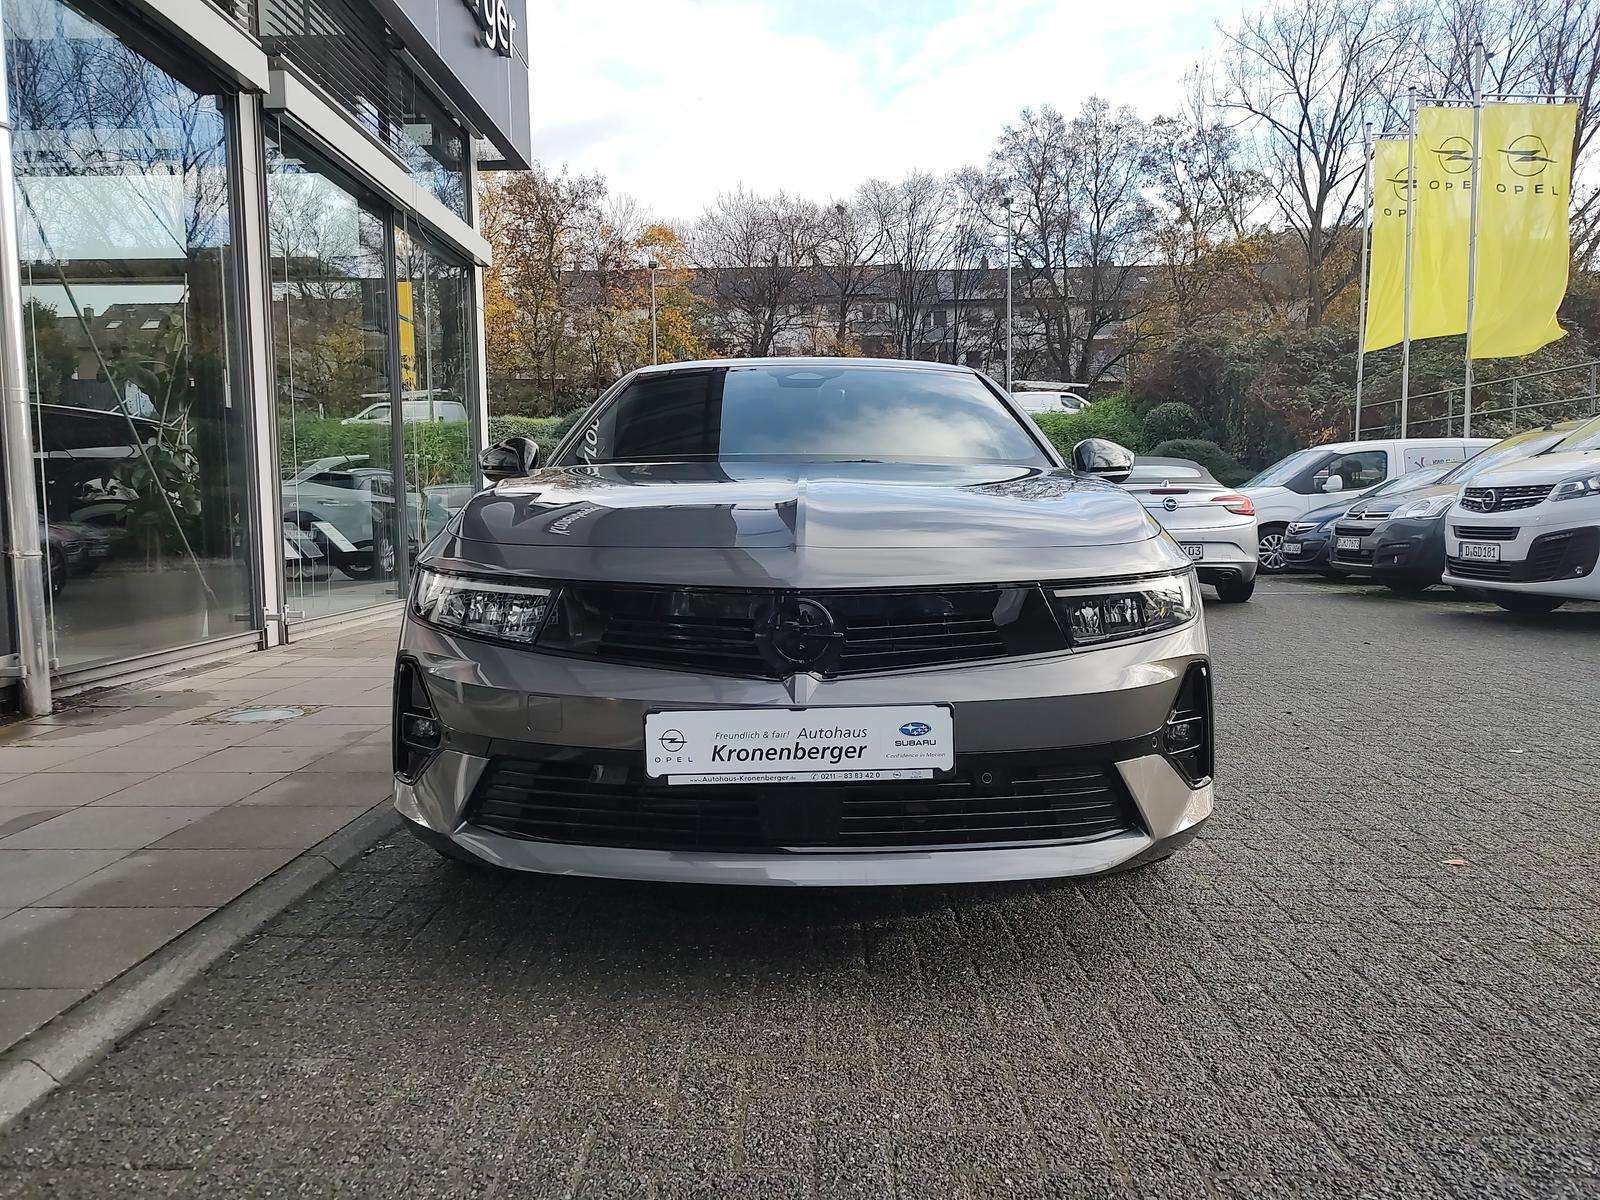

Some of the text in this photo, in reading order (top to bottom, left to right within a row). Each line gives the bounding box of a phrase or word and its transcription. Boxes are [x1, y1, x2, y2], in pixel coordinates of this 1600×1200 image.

[475, 0, 516, 58] ger
[1429, 180, 1471, 191] OPE
[1496, 183, 1558, 196] OPEL
[1383, 208, 1416, 218] OP
[1183, 546, 1201, 556] 03
[1473, 546, 1496, 558] GD181
[714, 726, 868, 740] Freundlich & fair! Autohaus
[894, 739, 937, 747] SUBARU
[711, 742, 868, 764] Kronenberger
